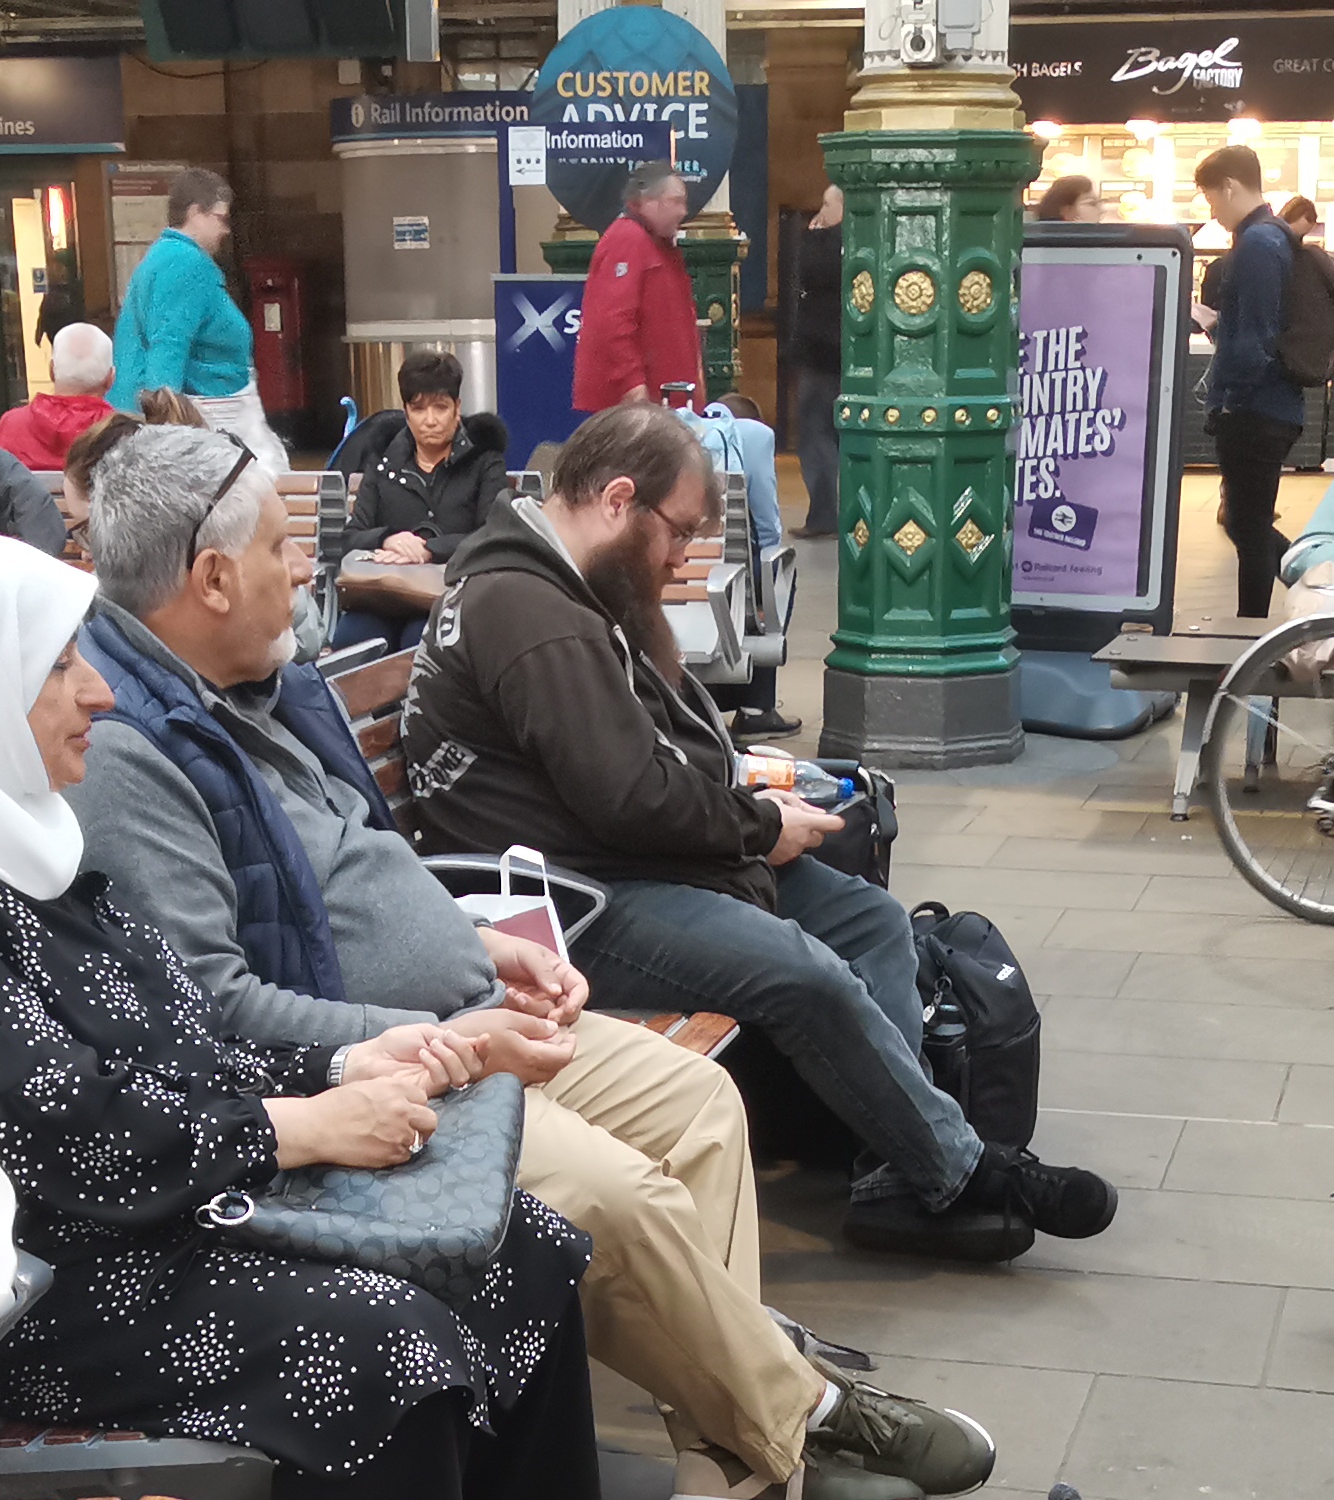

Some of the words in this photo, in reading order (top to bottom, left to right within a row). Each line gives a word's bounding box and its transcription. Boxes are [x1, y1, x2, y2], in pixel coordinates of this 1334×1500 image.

[1031, 61, 1083, 77] BAGELS
[1111, 37, 1242, 95] Bagel
[1273, 57, 1319, 73] GREAT
[556, 71, 710, 97] CUSTOMER
[1193, 68, 1243, 90] FACTORY
[370, 102, 400, 124] Rail
[406, 101, 529, 122] Information
[546, 130, 644, 149] Information
[1033, 325, 1083, 373] THE
